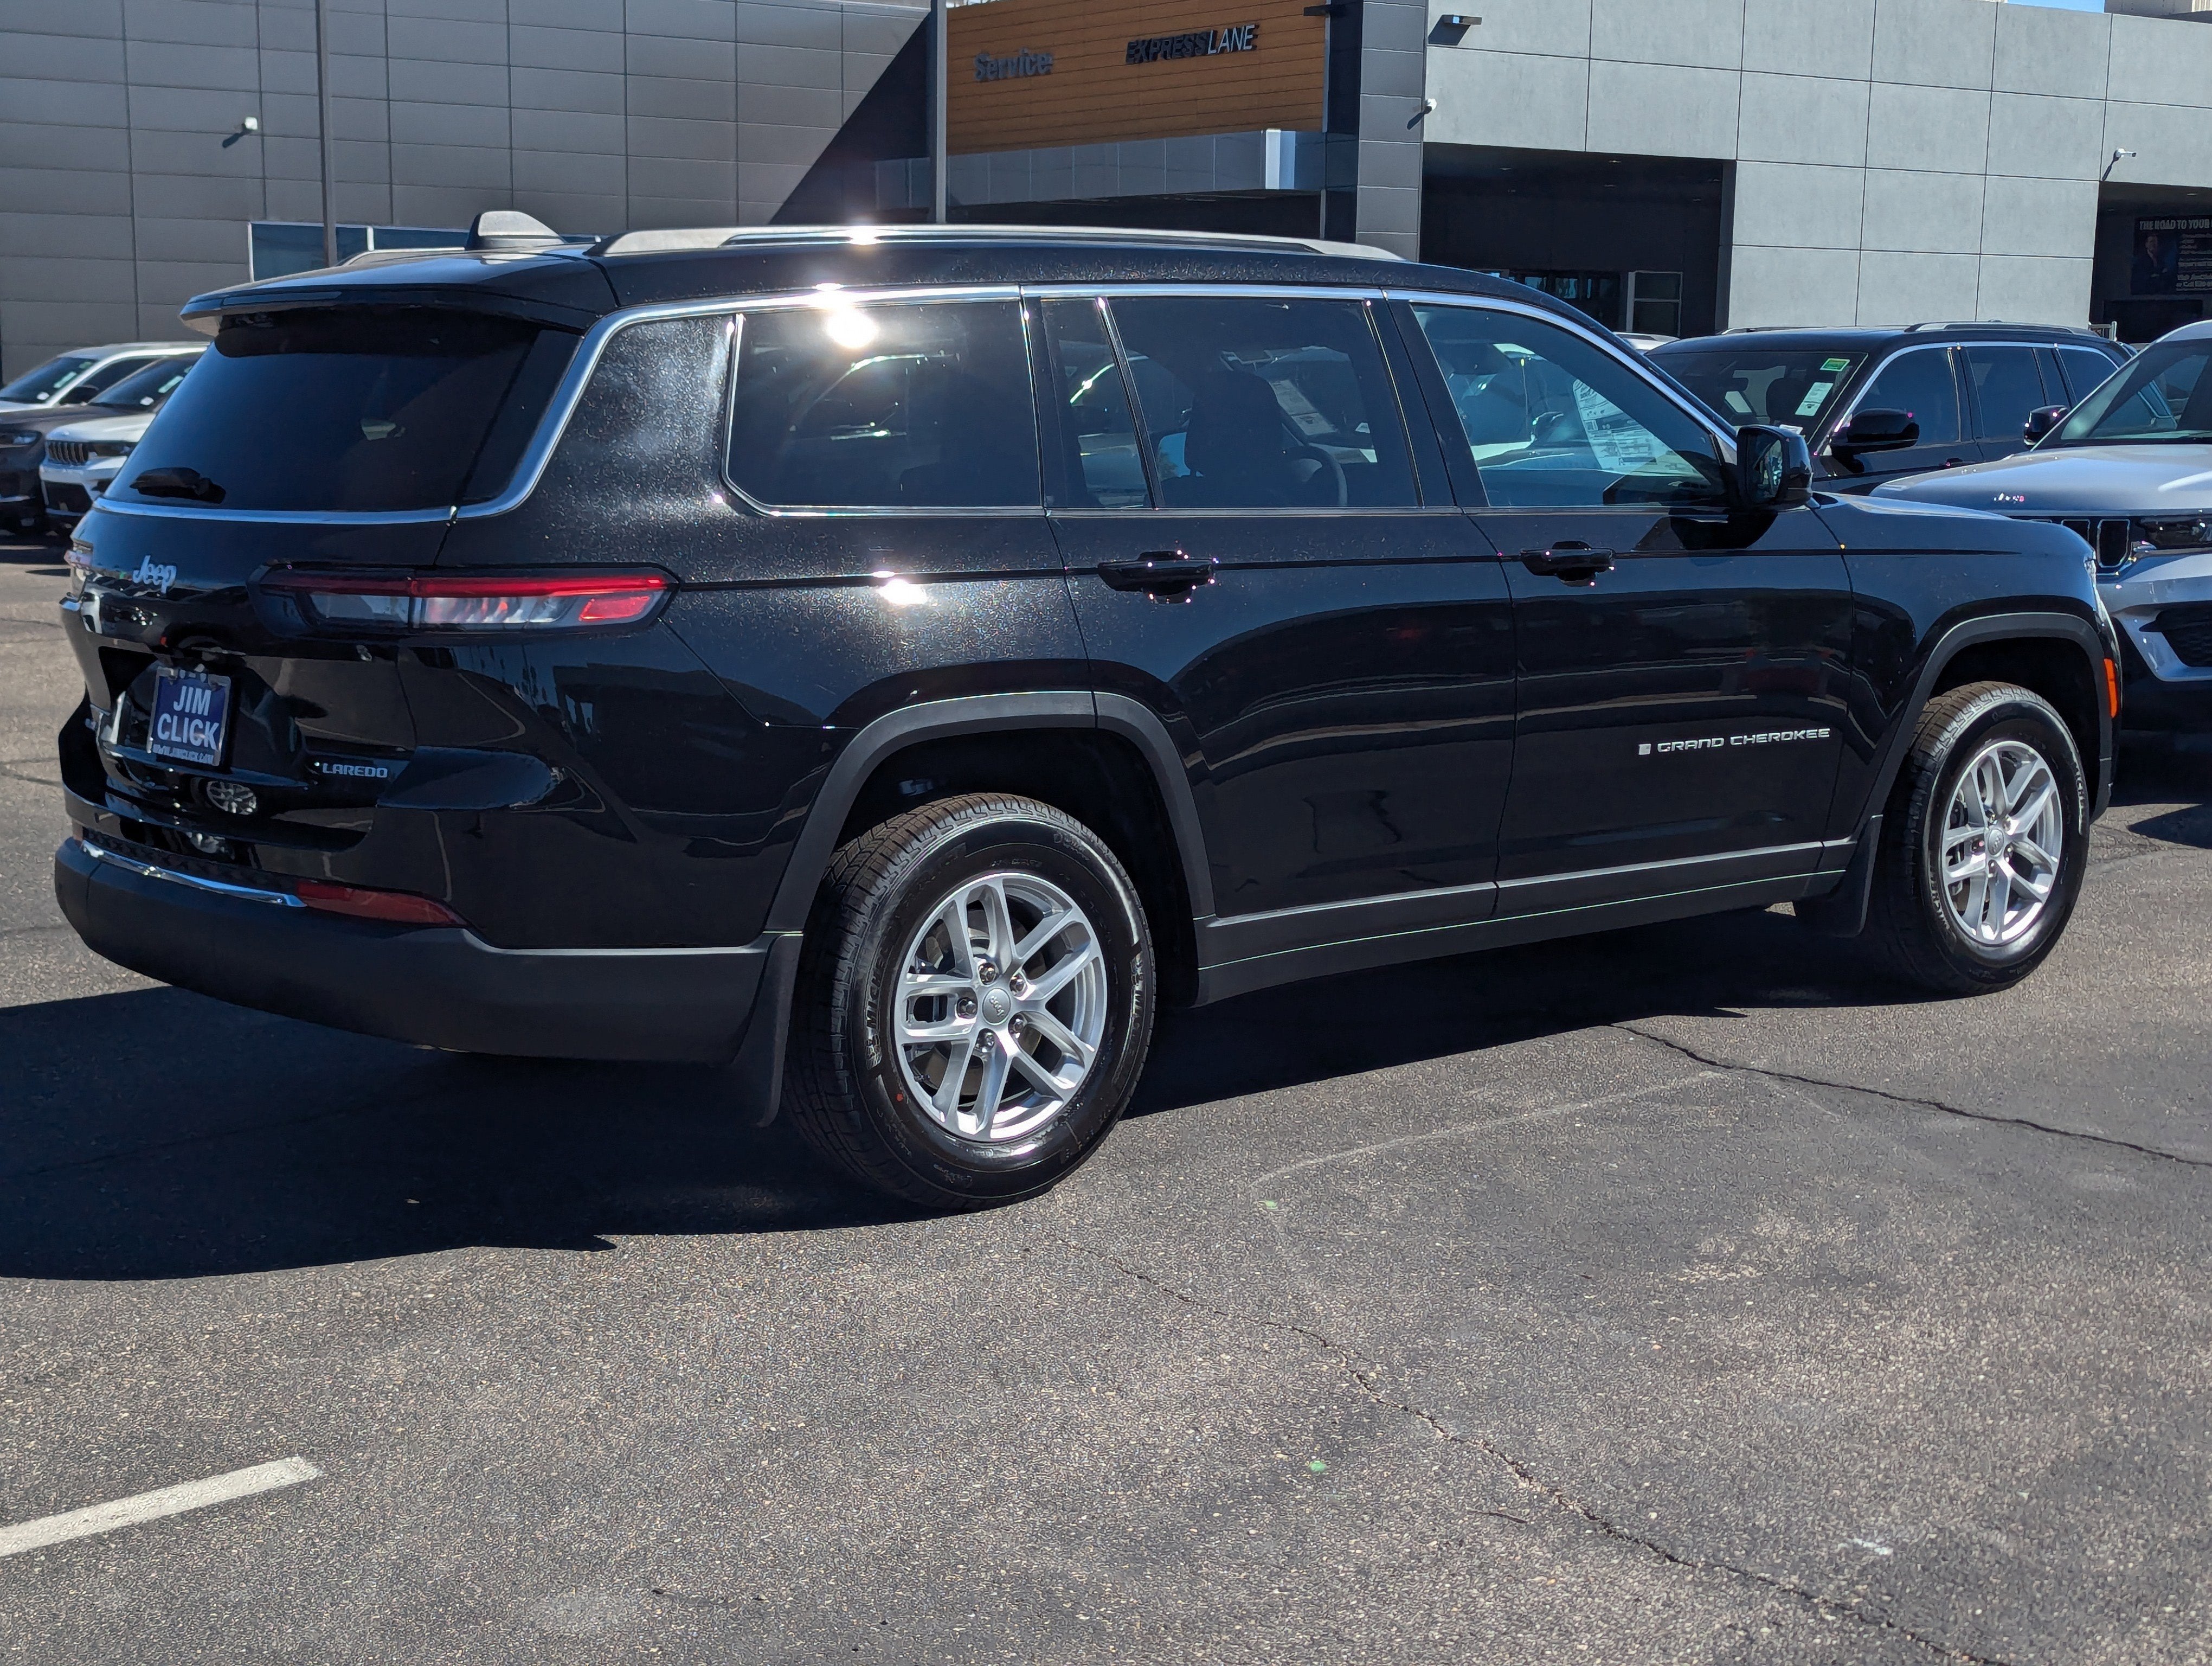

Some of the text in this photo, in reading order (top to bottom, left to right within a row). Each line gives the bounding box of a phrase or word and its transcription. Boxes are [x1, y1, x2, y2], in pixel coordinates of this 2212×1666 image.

[974, 47, 1052, 81] Service
[2177, 220, 2187, 229] TO
[133, 555, 177, 594] Jeep
[173, 685, 211, 716] JIM
[157, 713, 219, 750] CLICK
[1657, 728, 1830, 753] GRAND CHEROKEE
[323, 762, 388, 778] LAREDO
